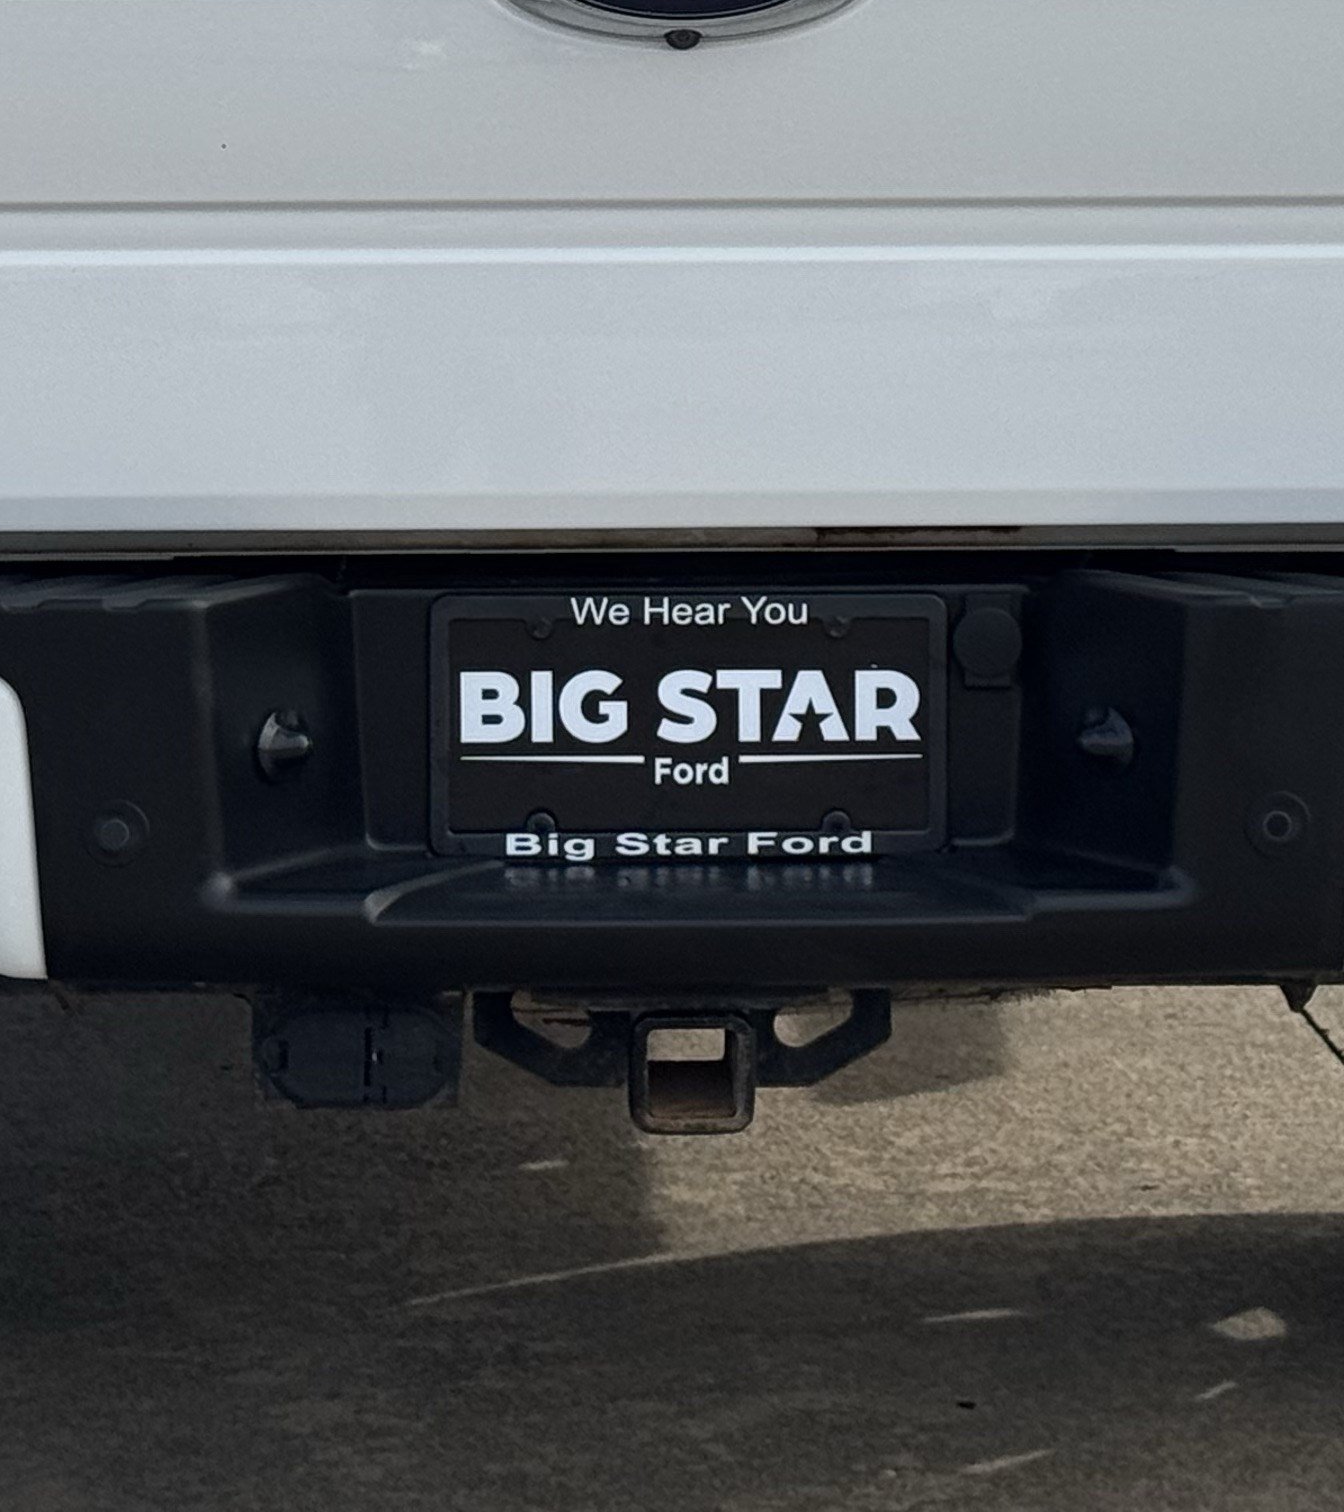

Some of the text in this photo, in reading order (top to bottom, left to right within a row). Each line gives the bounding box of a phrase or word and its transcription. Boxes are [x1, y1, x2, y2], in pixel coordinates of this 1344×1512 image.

[570, 595, 808, 625] We Hear You
[460, 669, 921, 743] BIG STAR
[654, 755, 729, 785] Ford
[505, 831, 873, 861] Big Star Ford
